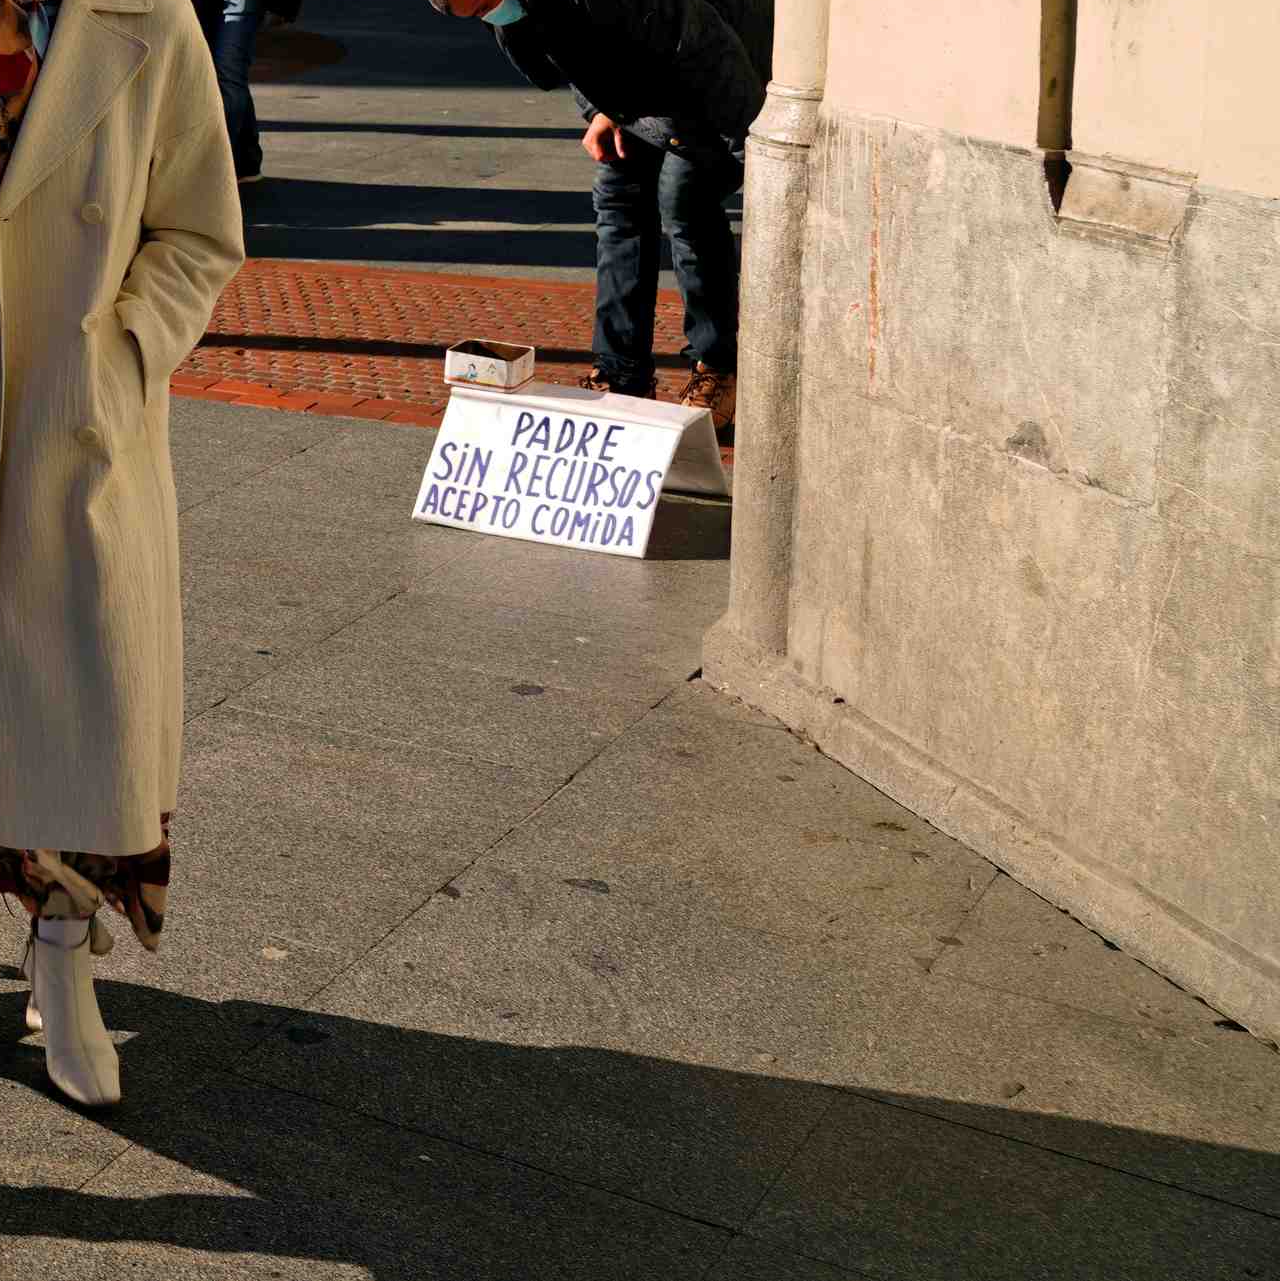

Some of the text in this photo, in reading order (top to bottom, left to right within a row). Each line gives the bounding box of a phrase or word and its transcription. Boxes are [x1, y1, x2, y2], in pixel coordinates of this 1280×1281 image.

[511, 412, 625, 462] PADRE
[504, 452, 662, 510] RECURSOS
[421, 484, 521, 529] ACEPTO
